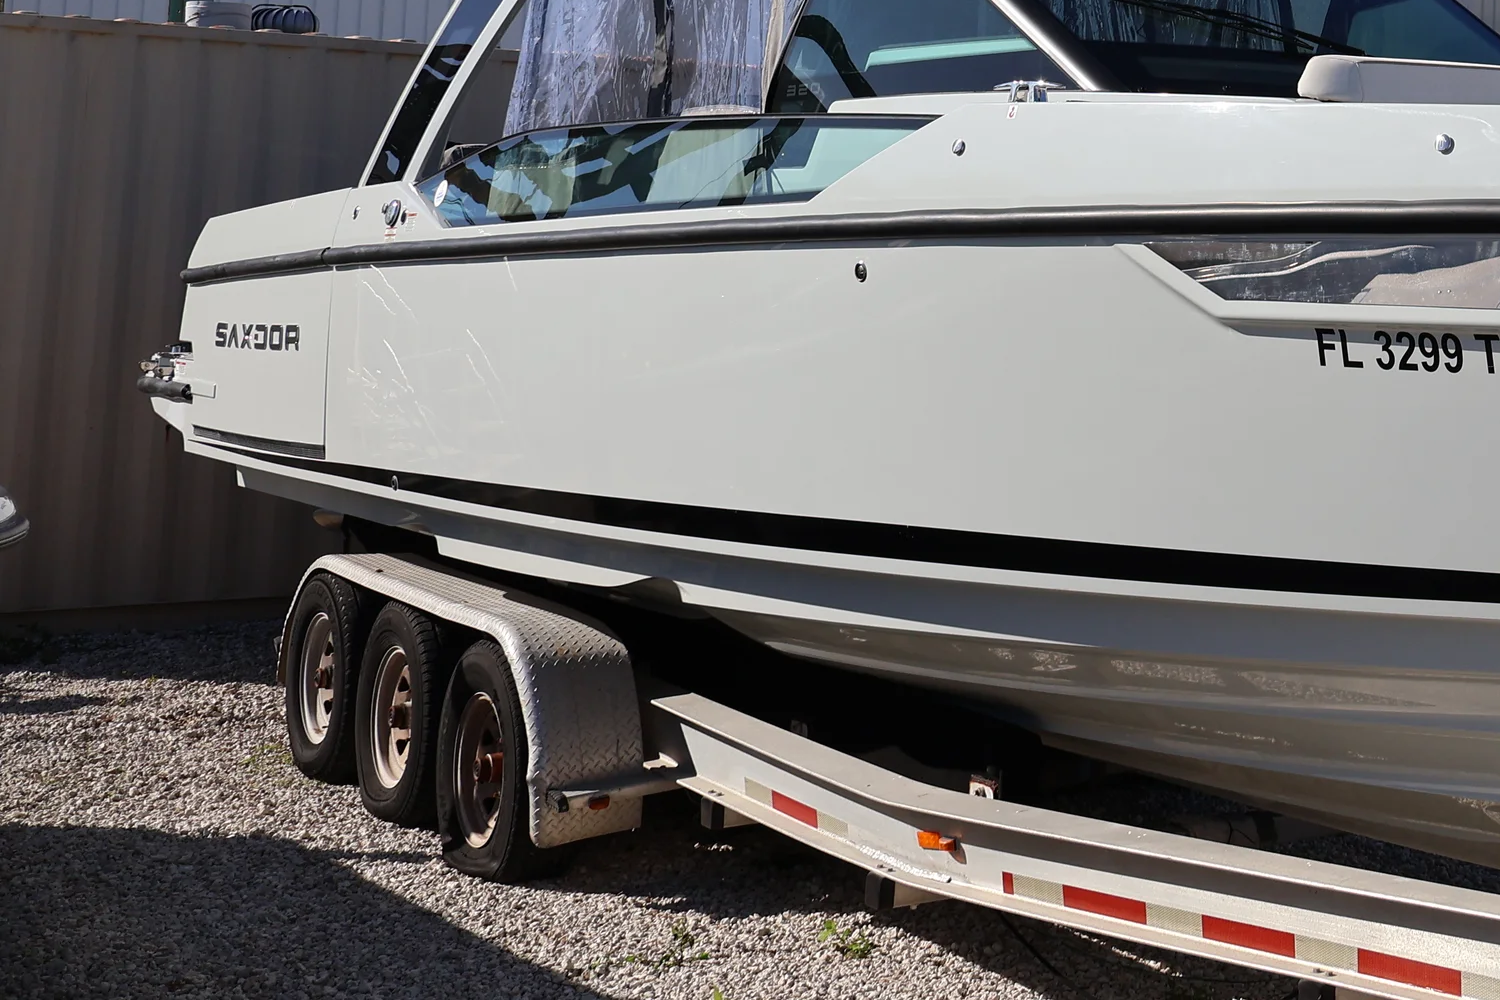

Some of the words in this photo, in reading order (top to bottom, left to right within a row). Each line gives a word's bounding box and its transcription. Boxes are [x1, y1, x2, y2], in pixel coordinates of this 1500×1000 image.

[215, 322, 300, 352] SAXDOR
[1314, 327, 1364, 369] FL
[1373, 330, 1464, 374] 3299
